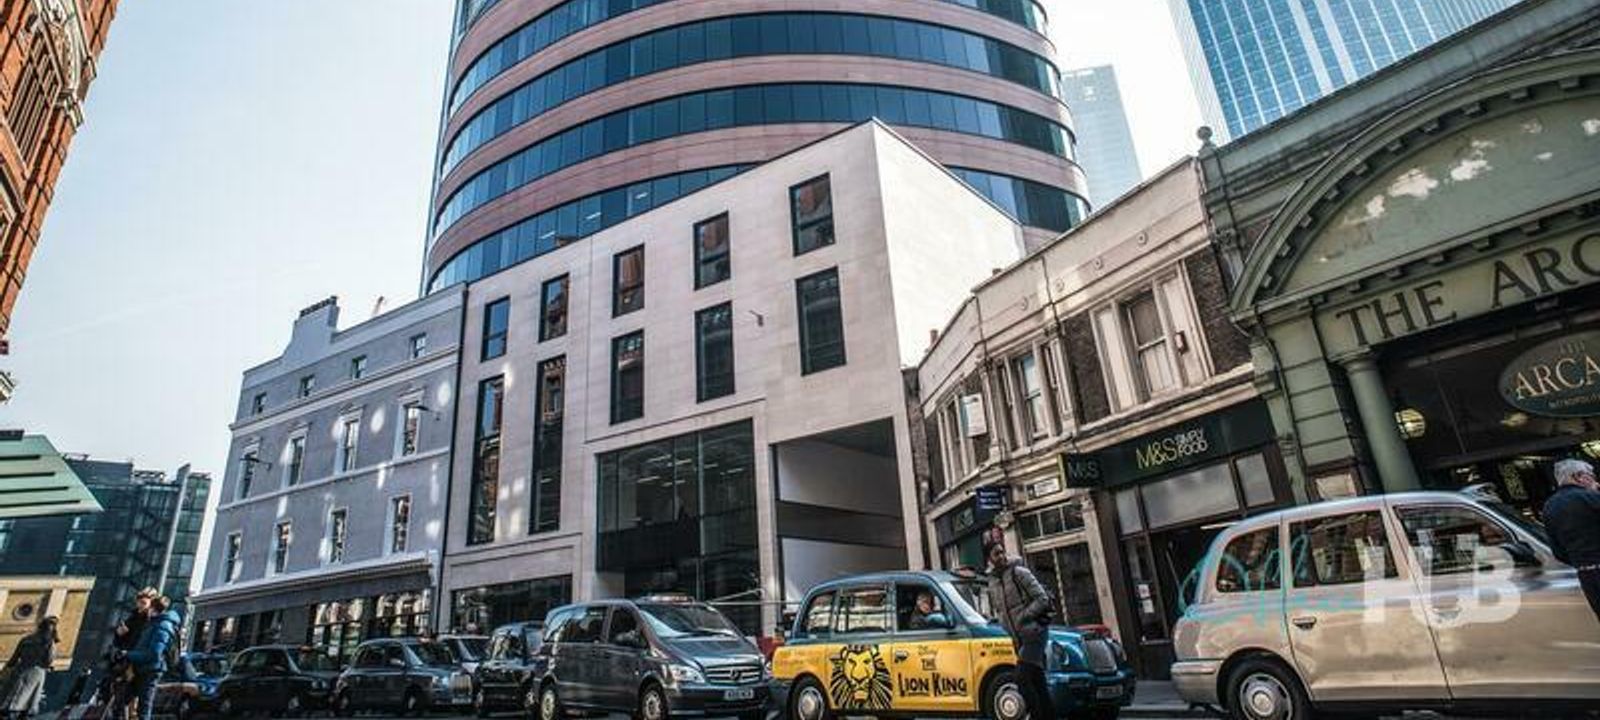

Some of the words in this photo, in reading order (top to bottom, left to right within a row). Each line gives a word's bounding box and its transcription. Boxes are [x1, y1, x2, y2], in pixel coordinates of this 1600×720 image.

[1336, 280, 1457, 346] THE
[1136, 438, 1177, 470] M&S
[1178, 439, 1207, 458] FOOD
